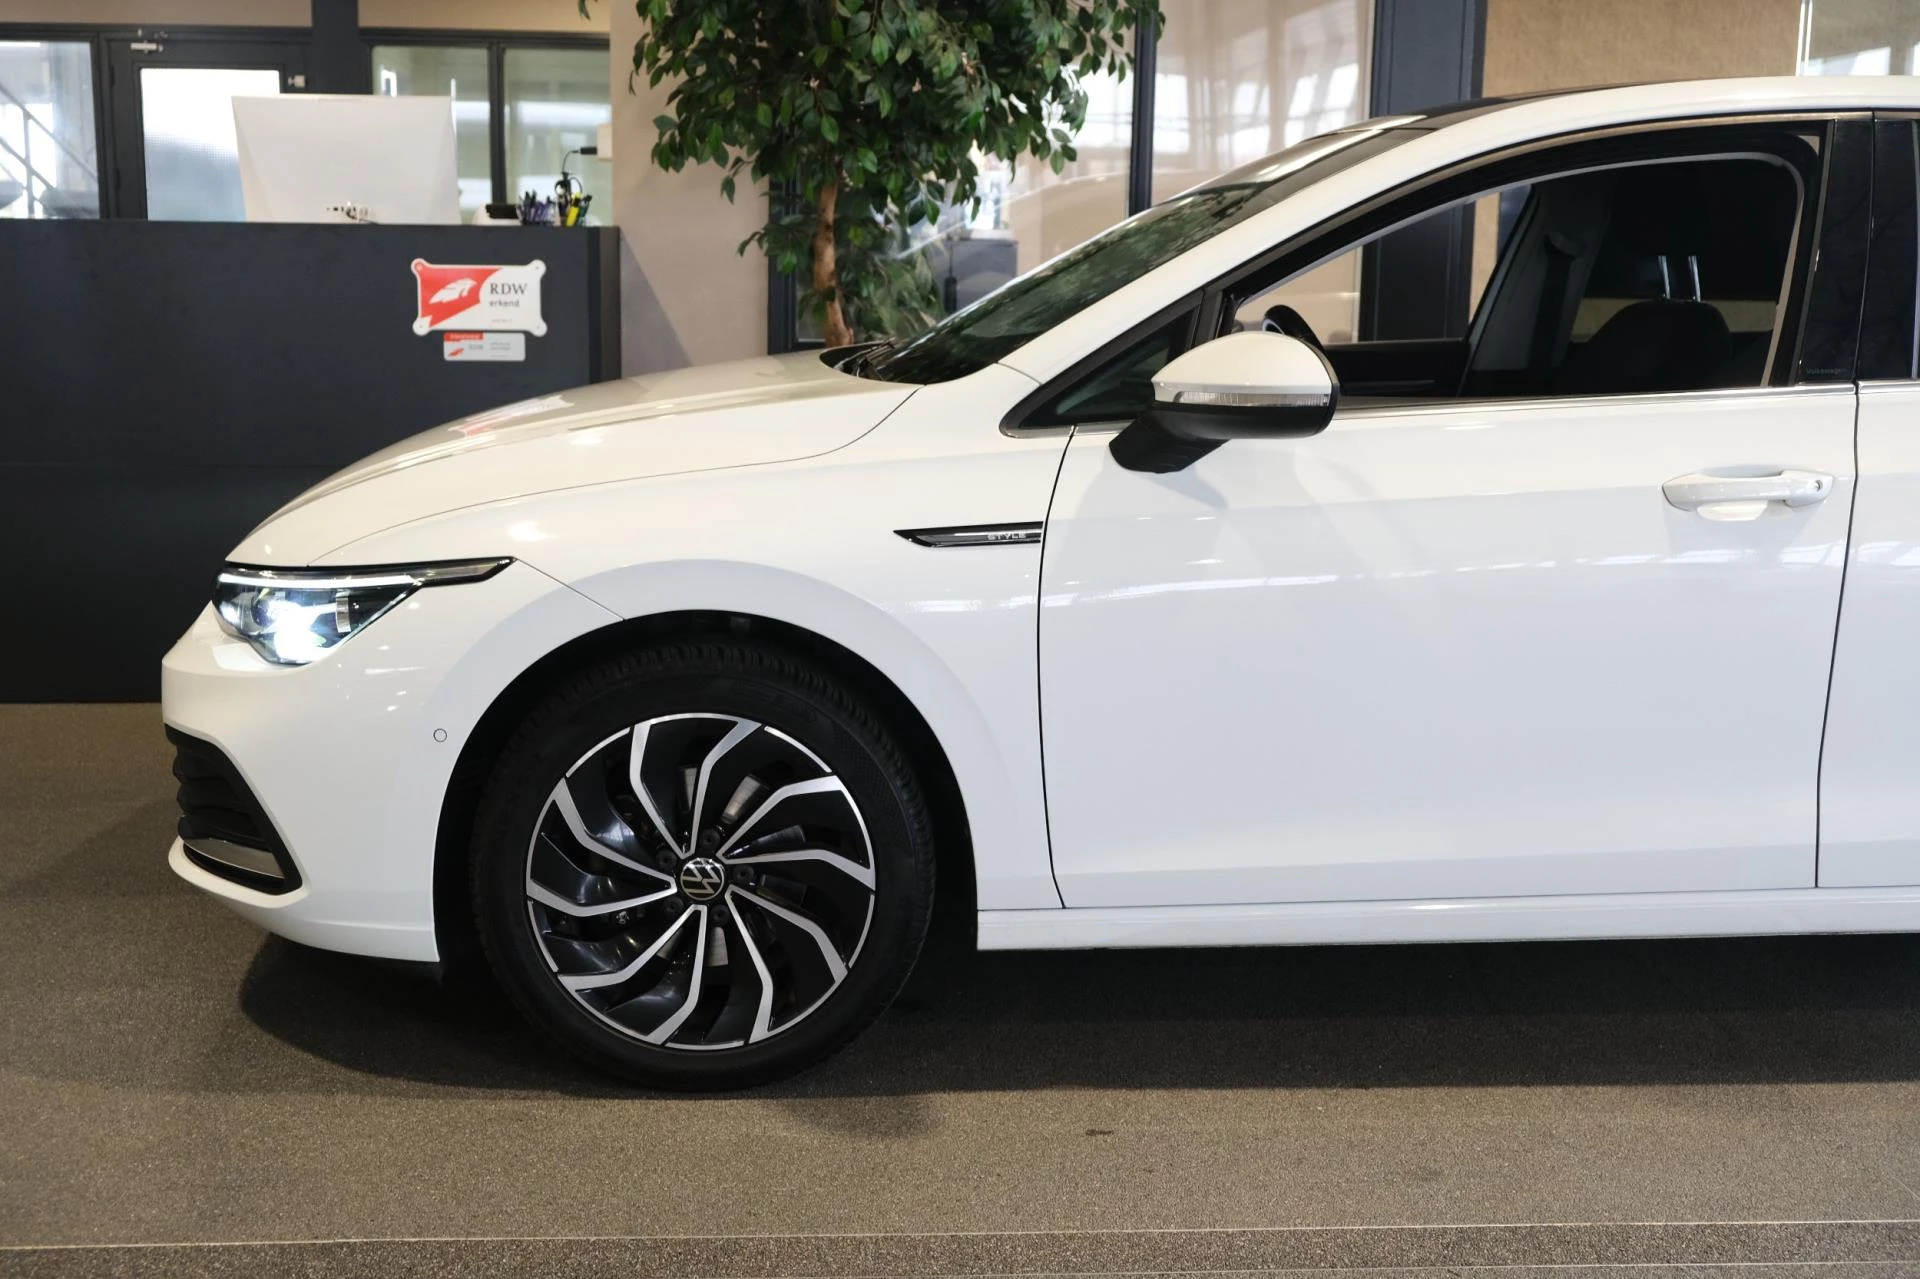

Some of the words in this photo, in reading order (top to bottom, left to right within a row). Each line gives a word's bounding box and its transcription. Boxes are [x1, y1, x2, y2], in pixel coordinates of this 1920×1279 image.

[490, 282, 528, 295] RDW
[489, 298, 520, 308] erkend
[986, 532, 1026, 541] STYLE
